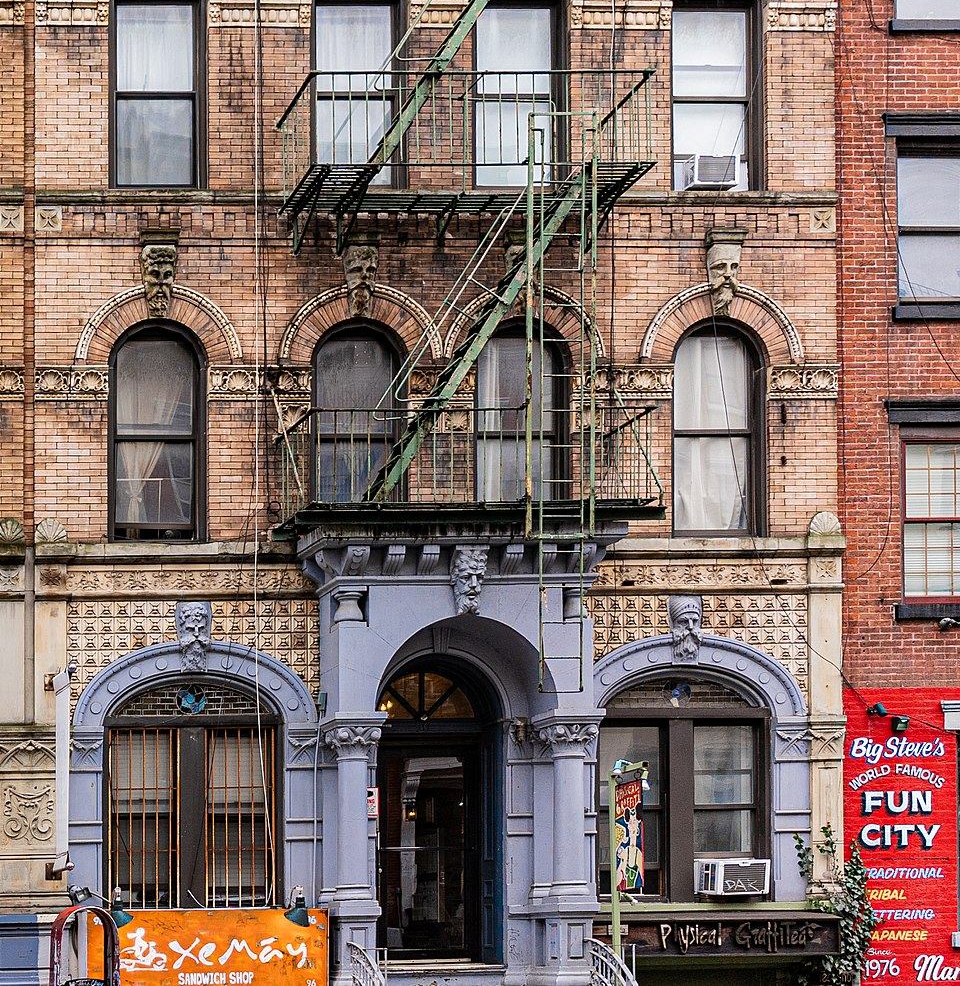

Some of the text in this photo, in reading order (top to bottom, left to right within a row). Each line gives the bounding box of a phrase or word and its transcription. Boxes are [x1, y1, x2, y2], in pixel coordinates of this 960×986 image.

[850, 736, 945, 764] Big Steve's
[848, 764, 945, 790] WORLD FAMOUS
[863, 790, 933, 813] FUN
[860, 823, 941, 847] CITY
[867, 889, 907, 900] RIBAL
[871, 909, 935, 920] ETTERING
[870, 930, 928, 941] APANESE
[177, 971, 254, 985] SANDWICH SHOP
[865, 957, 900, 979] 1976
